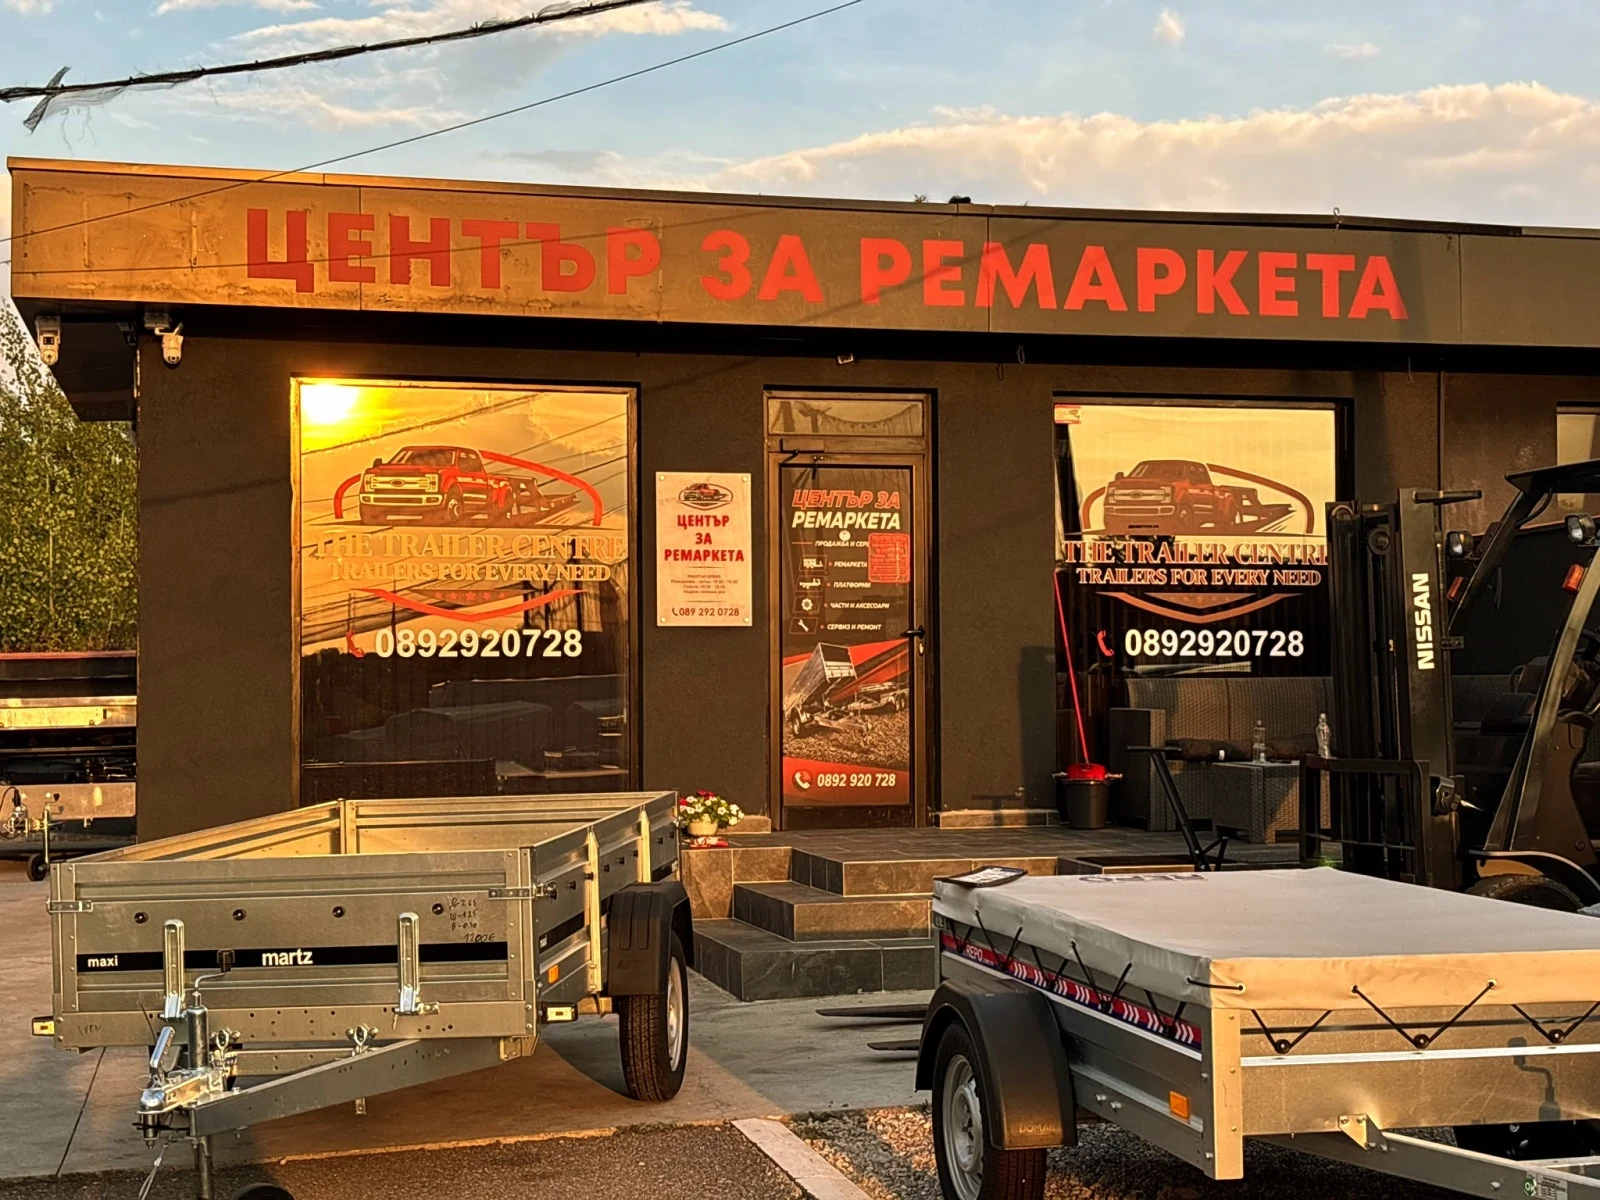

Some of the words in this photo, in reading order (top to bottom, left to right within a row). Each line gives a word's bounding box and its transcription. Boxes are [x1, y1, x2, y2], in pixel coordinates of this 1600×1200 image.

[247, 207, 662, 294] ЦЕНТЪР
[701, 229, 823, 304] ЗА
[859, 236, 1410, 320] РЕМАРКЕТА
[792, 489, 874, 510] ЦЕНТЪР
[875, 491, 901, 509] ЗА
[677, 514, 730, 529] ЦЕНТЪР
[791, 511, 901, 529] РЕМАРКЕТА
[313, 532, 373, 558] THE
[378, 532, 509, 559] TRAILER
[511, 534, 628, 560] CENTRE
[695, 532, 713, 545] ЗА
[664, 549, 745, 562] РЕМАРКЕТА
[1062, 541, 1116, 564] THE
[1119, 541, 1230, 565] TRAILER
[327, 562, 436, 581] TRAILERS
[438, 563, 484, 581] FOR
[485, 563, 553, 582] EVERY
[555, 563, 612, 582] NEED
[1076, 568, 1167, 585] TRAILERS
[1170, 568, 1209, 585] FOR
[1211, 568, 1270, 586] EVERY
[1272, 569, 1322, 586] NEED
[679, 607, 696, 617] 089
[698, 607, 716, 617] 292
[717, 607, 740, 617] 0728
[1412, 573, 1435, 670] NISSAN
[375, 628, 583, 658] 0892920728
[1125, 628, 1305, 657] 0892920728
[816, 773, 847, 787] 0892
[849, 773, 872, 787] 920
[875, 773, 897, 787] 728
[87, 954, 119, 967] maxi
[261, 948, 314, 967] martz
